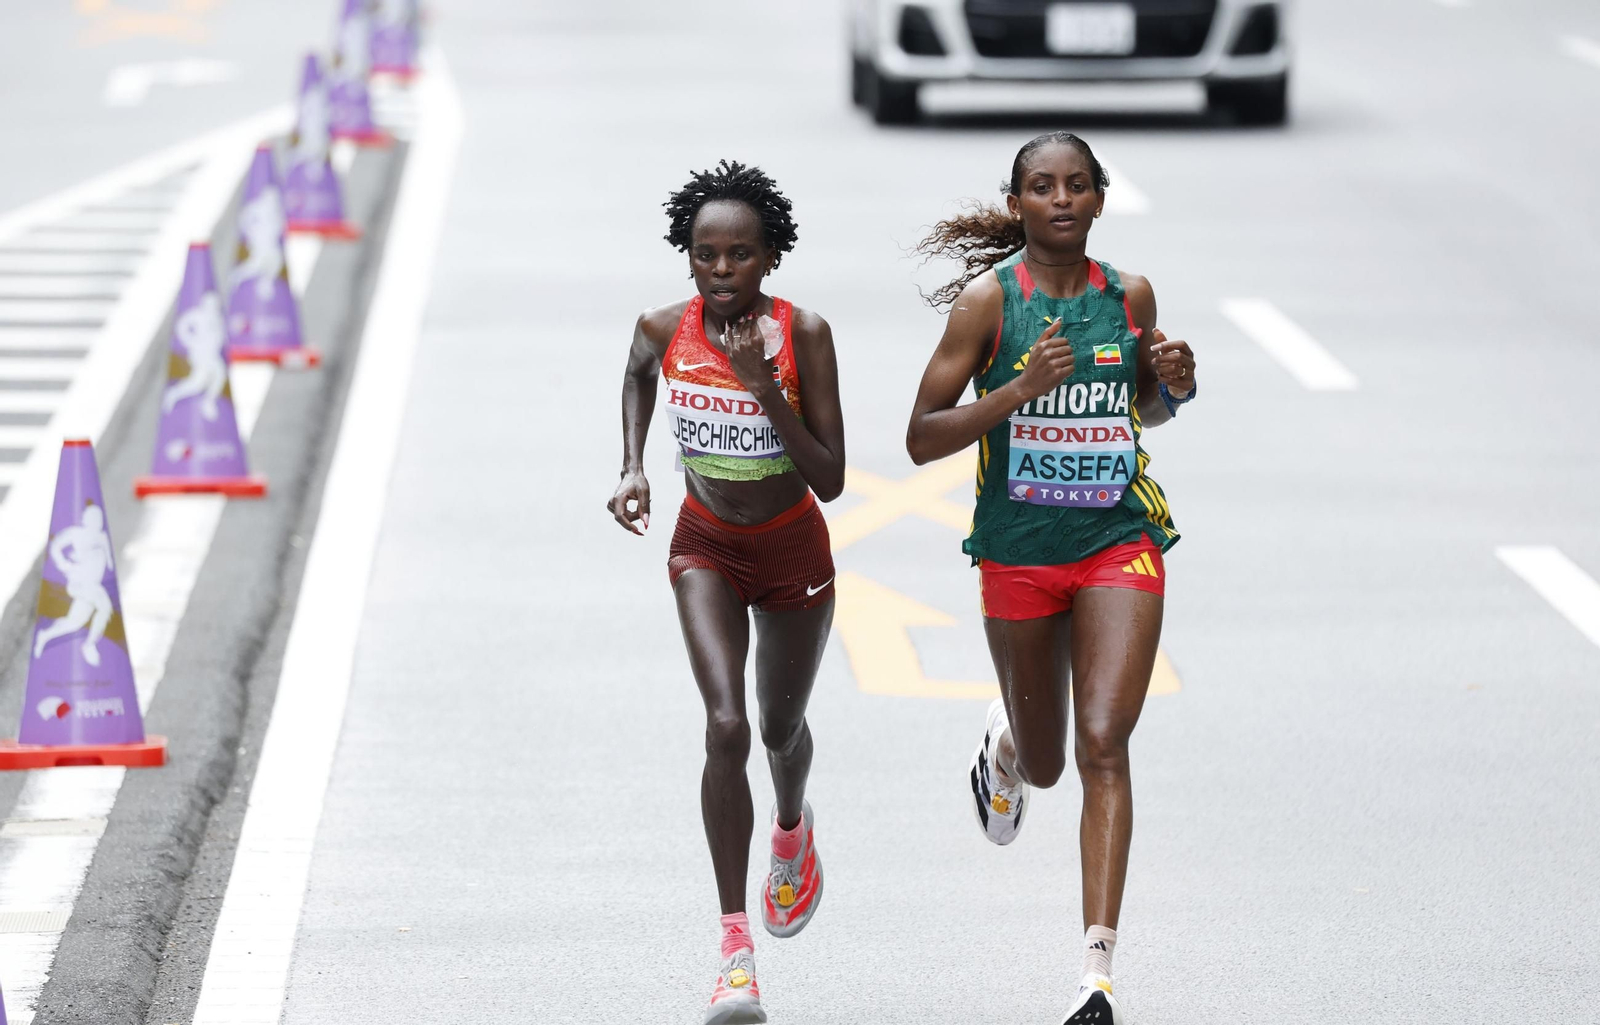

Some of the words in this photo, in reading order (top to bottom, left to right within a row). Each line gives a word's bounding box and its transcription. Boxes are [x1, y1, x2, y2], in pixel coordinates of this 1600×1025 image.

[1012, 382, 1129, 415] HIOPIA
[673, 416, 780, 452] JEPCHIRCHIR
[1013, 424, 1132, 443] HONDA
[1016, 453, 1129, 481] ASSEFA
